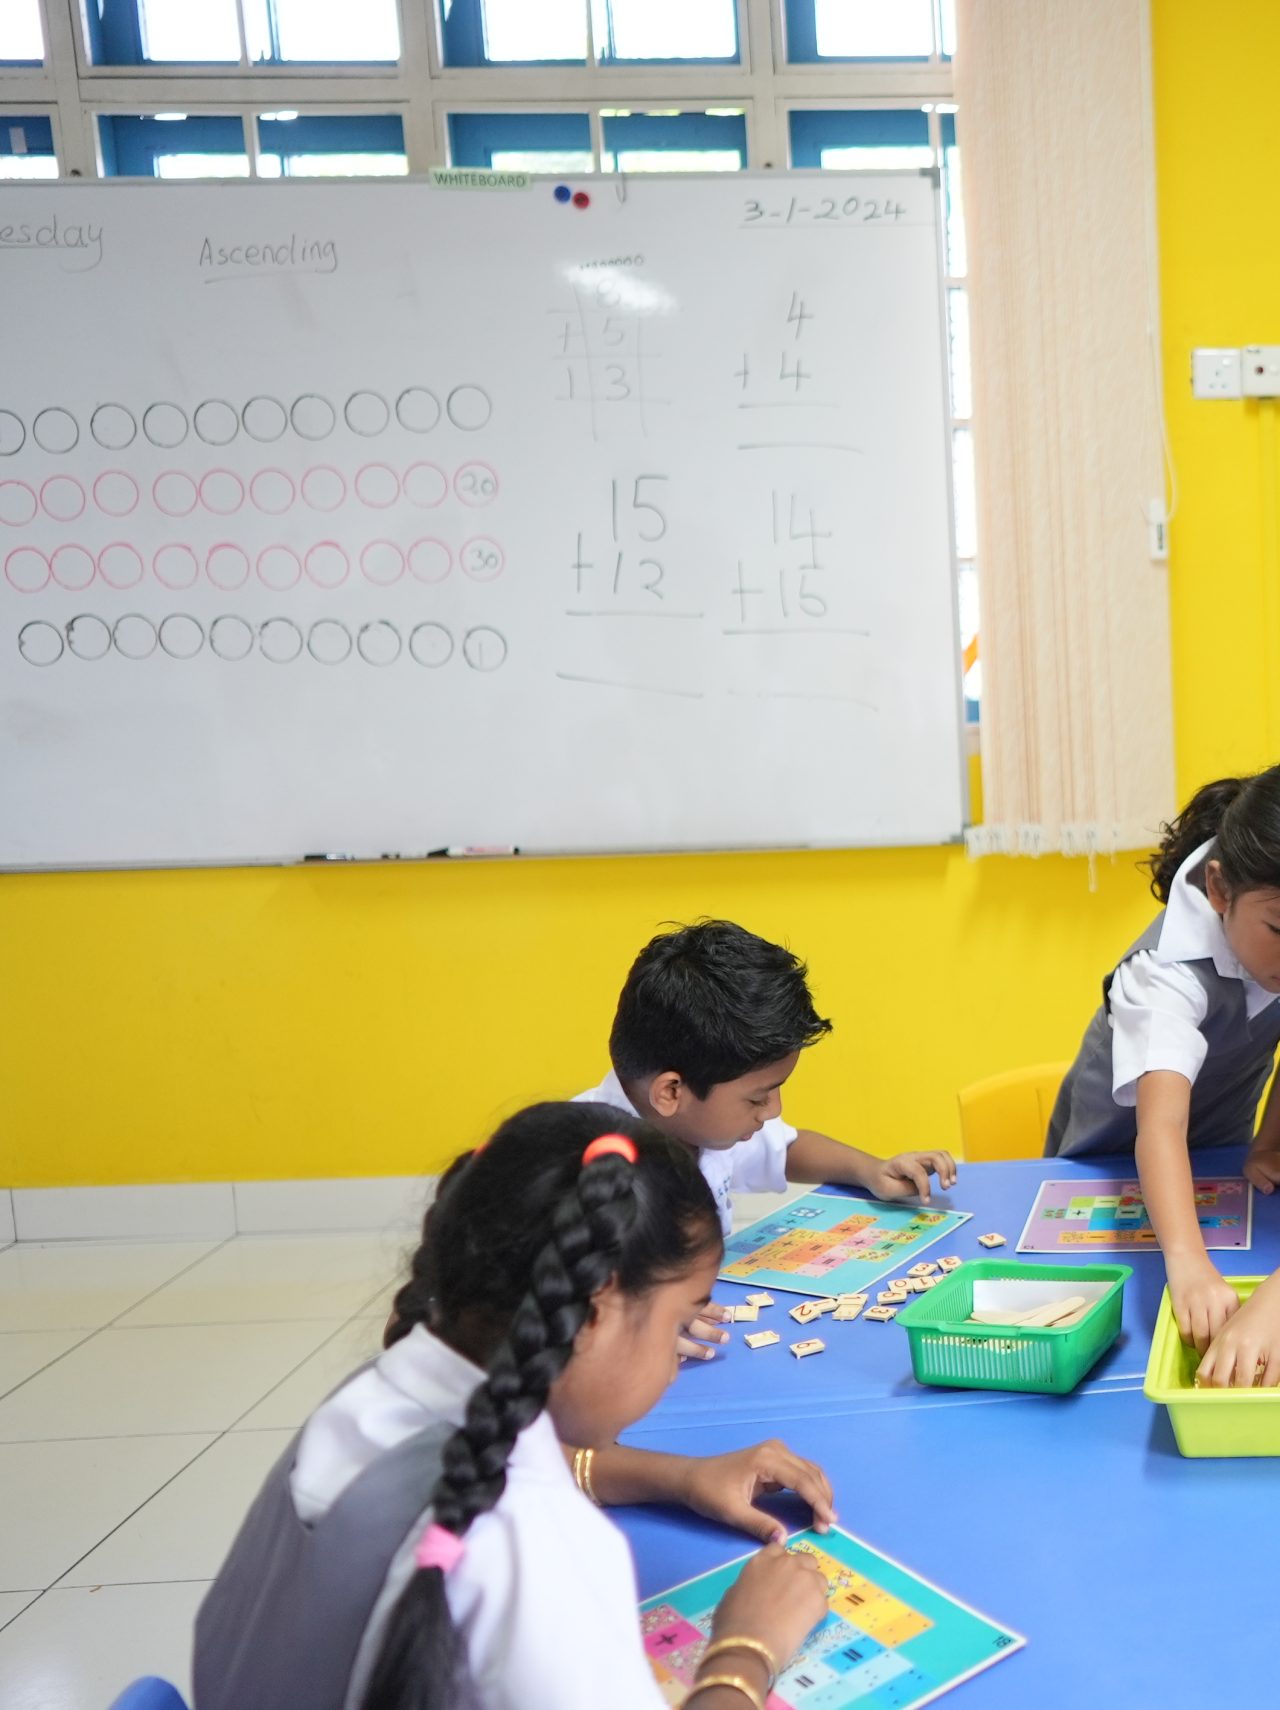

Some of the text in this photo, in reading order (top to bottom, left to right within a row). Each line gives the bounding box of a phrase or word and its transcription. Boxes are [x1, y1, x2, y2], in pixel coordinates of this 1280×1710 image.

[434, 173, 526, 188] WHITEBOARD
[743, 197, 906, 223] 3-1-2024
[200, 234, 339, 274] Ascending
[786, 290, 814, 340] 4
[611, 475, 669, 543] 15
[772, 489, 833, 570] 14
